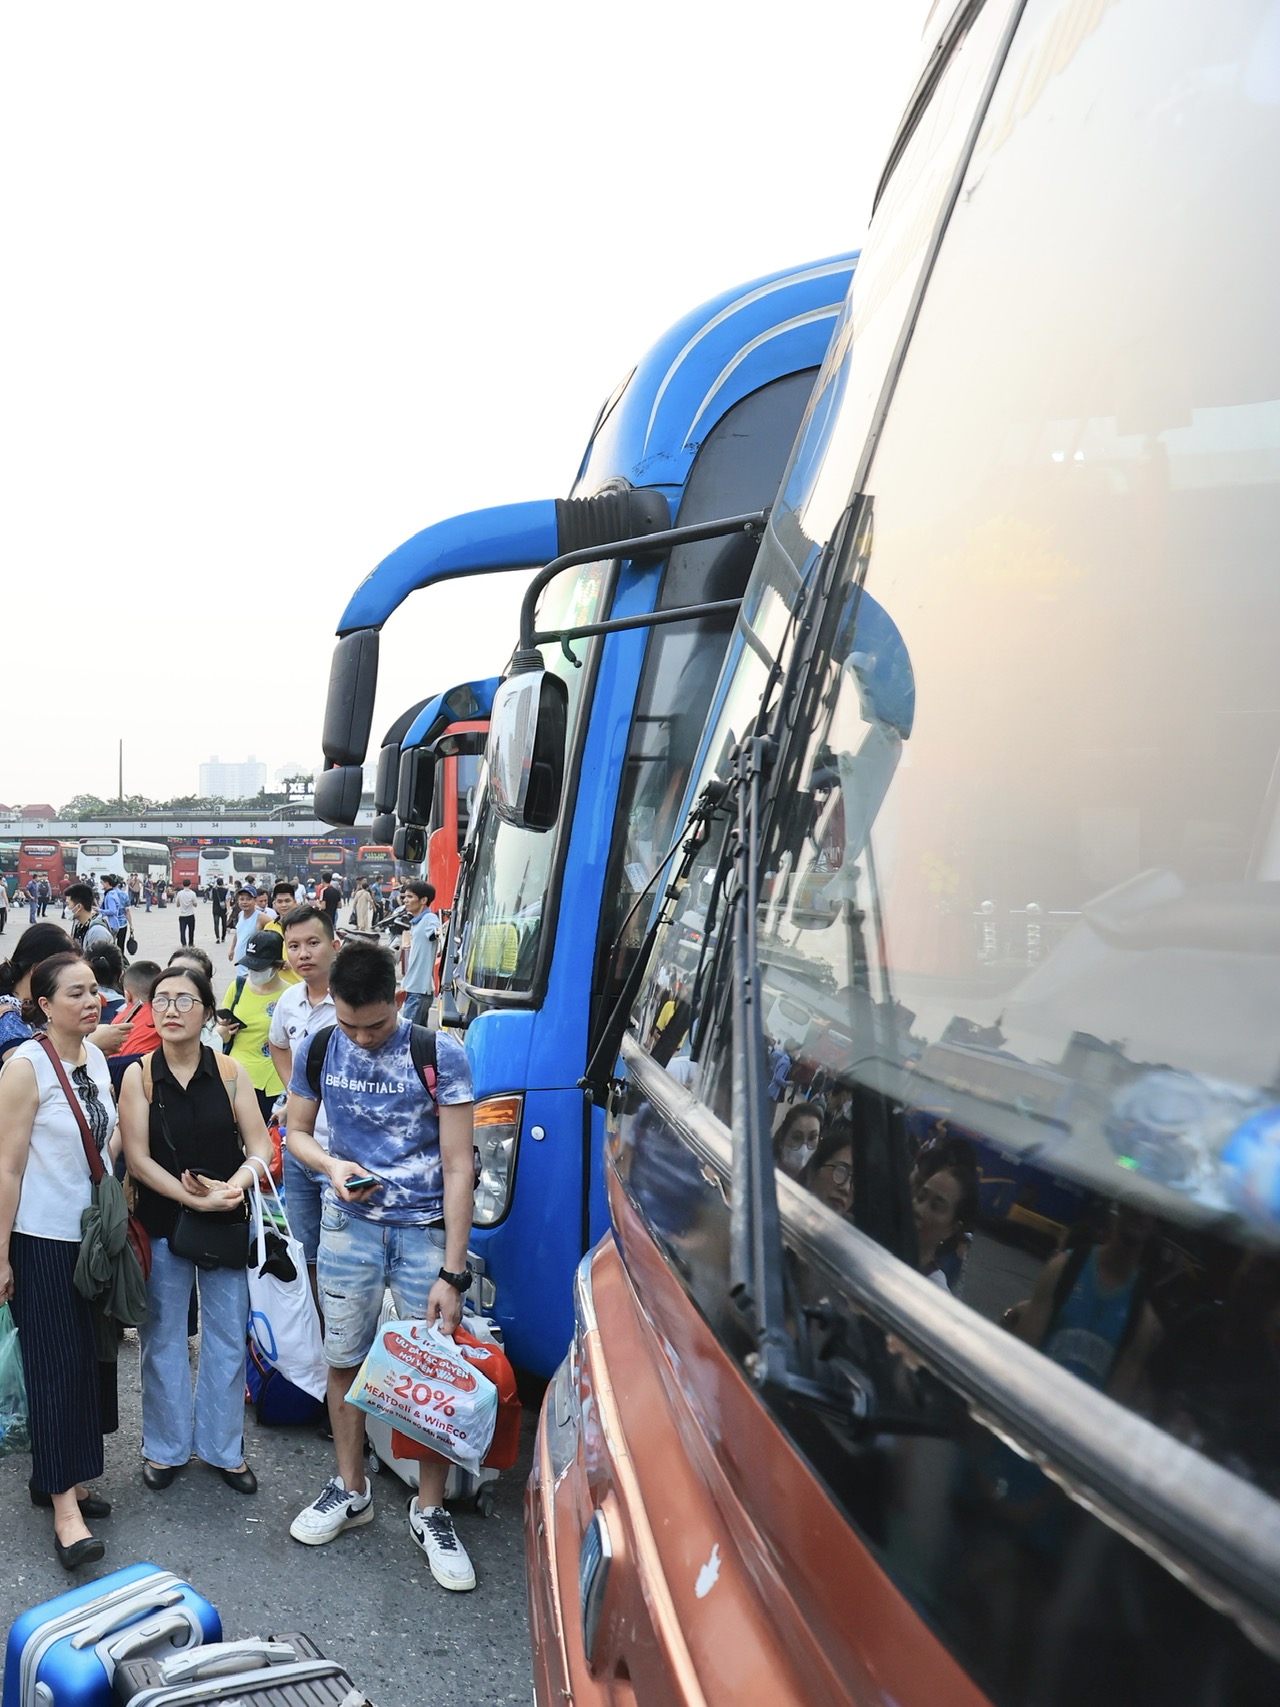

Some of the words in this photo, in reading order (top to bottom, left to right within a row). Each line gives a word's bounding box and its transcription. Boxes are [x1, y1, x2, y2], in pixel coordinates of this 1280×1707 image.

[364, 1382, 411, 1414] MEATDeli
[413, 1410, 421, 1419] &
[394, 1375, 456, 1417] 20%
